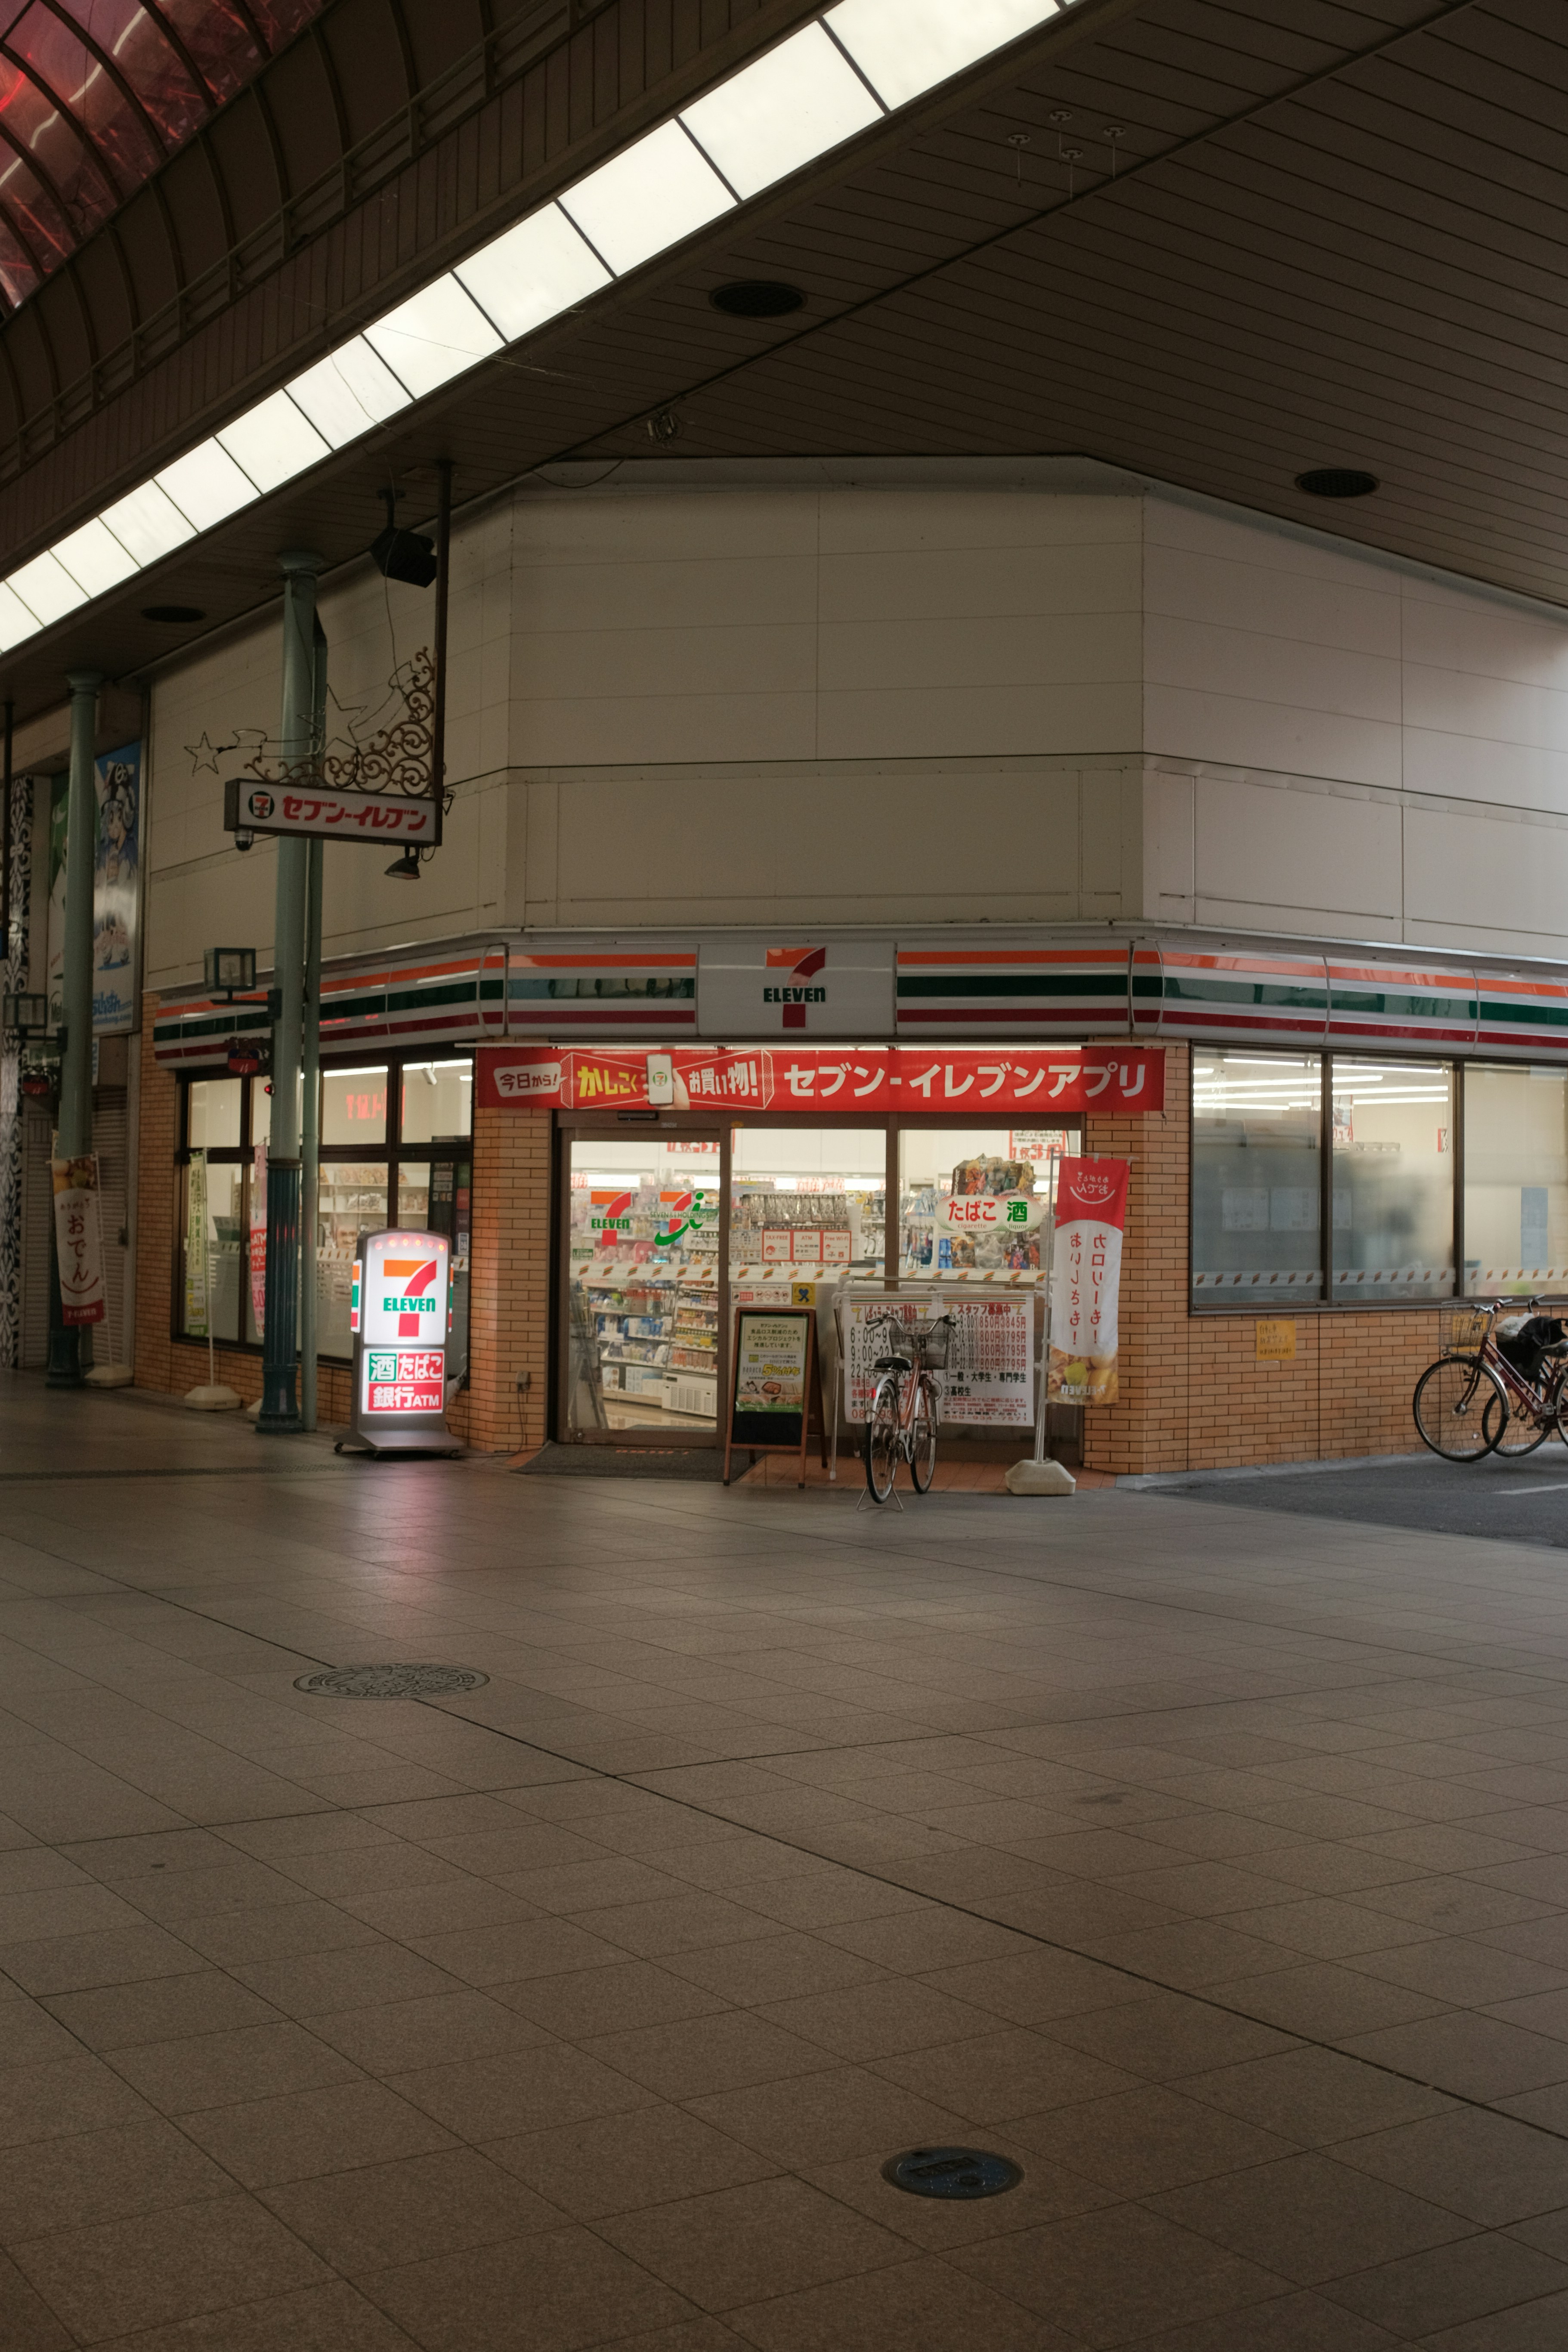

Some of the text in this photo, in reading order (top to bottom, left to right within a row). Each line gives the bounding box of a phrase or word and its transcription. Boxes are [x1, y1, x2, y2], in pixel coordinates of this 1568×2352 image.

[766, 947, 826, 1028] 7
[578, 1065, 637, 1097] かしこく
[591, 1191, 631, 1245] 7
[949, 1201, 1028, 1222] たばこ 酒
[68, 1215, 89, 1283] おでん
[383, 1259, 437, 1337] 7
[958, 1304, 1011, 1315] スタッフ募集中
[370, 1352, 443, 1381] 酒 たばこ
